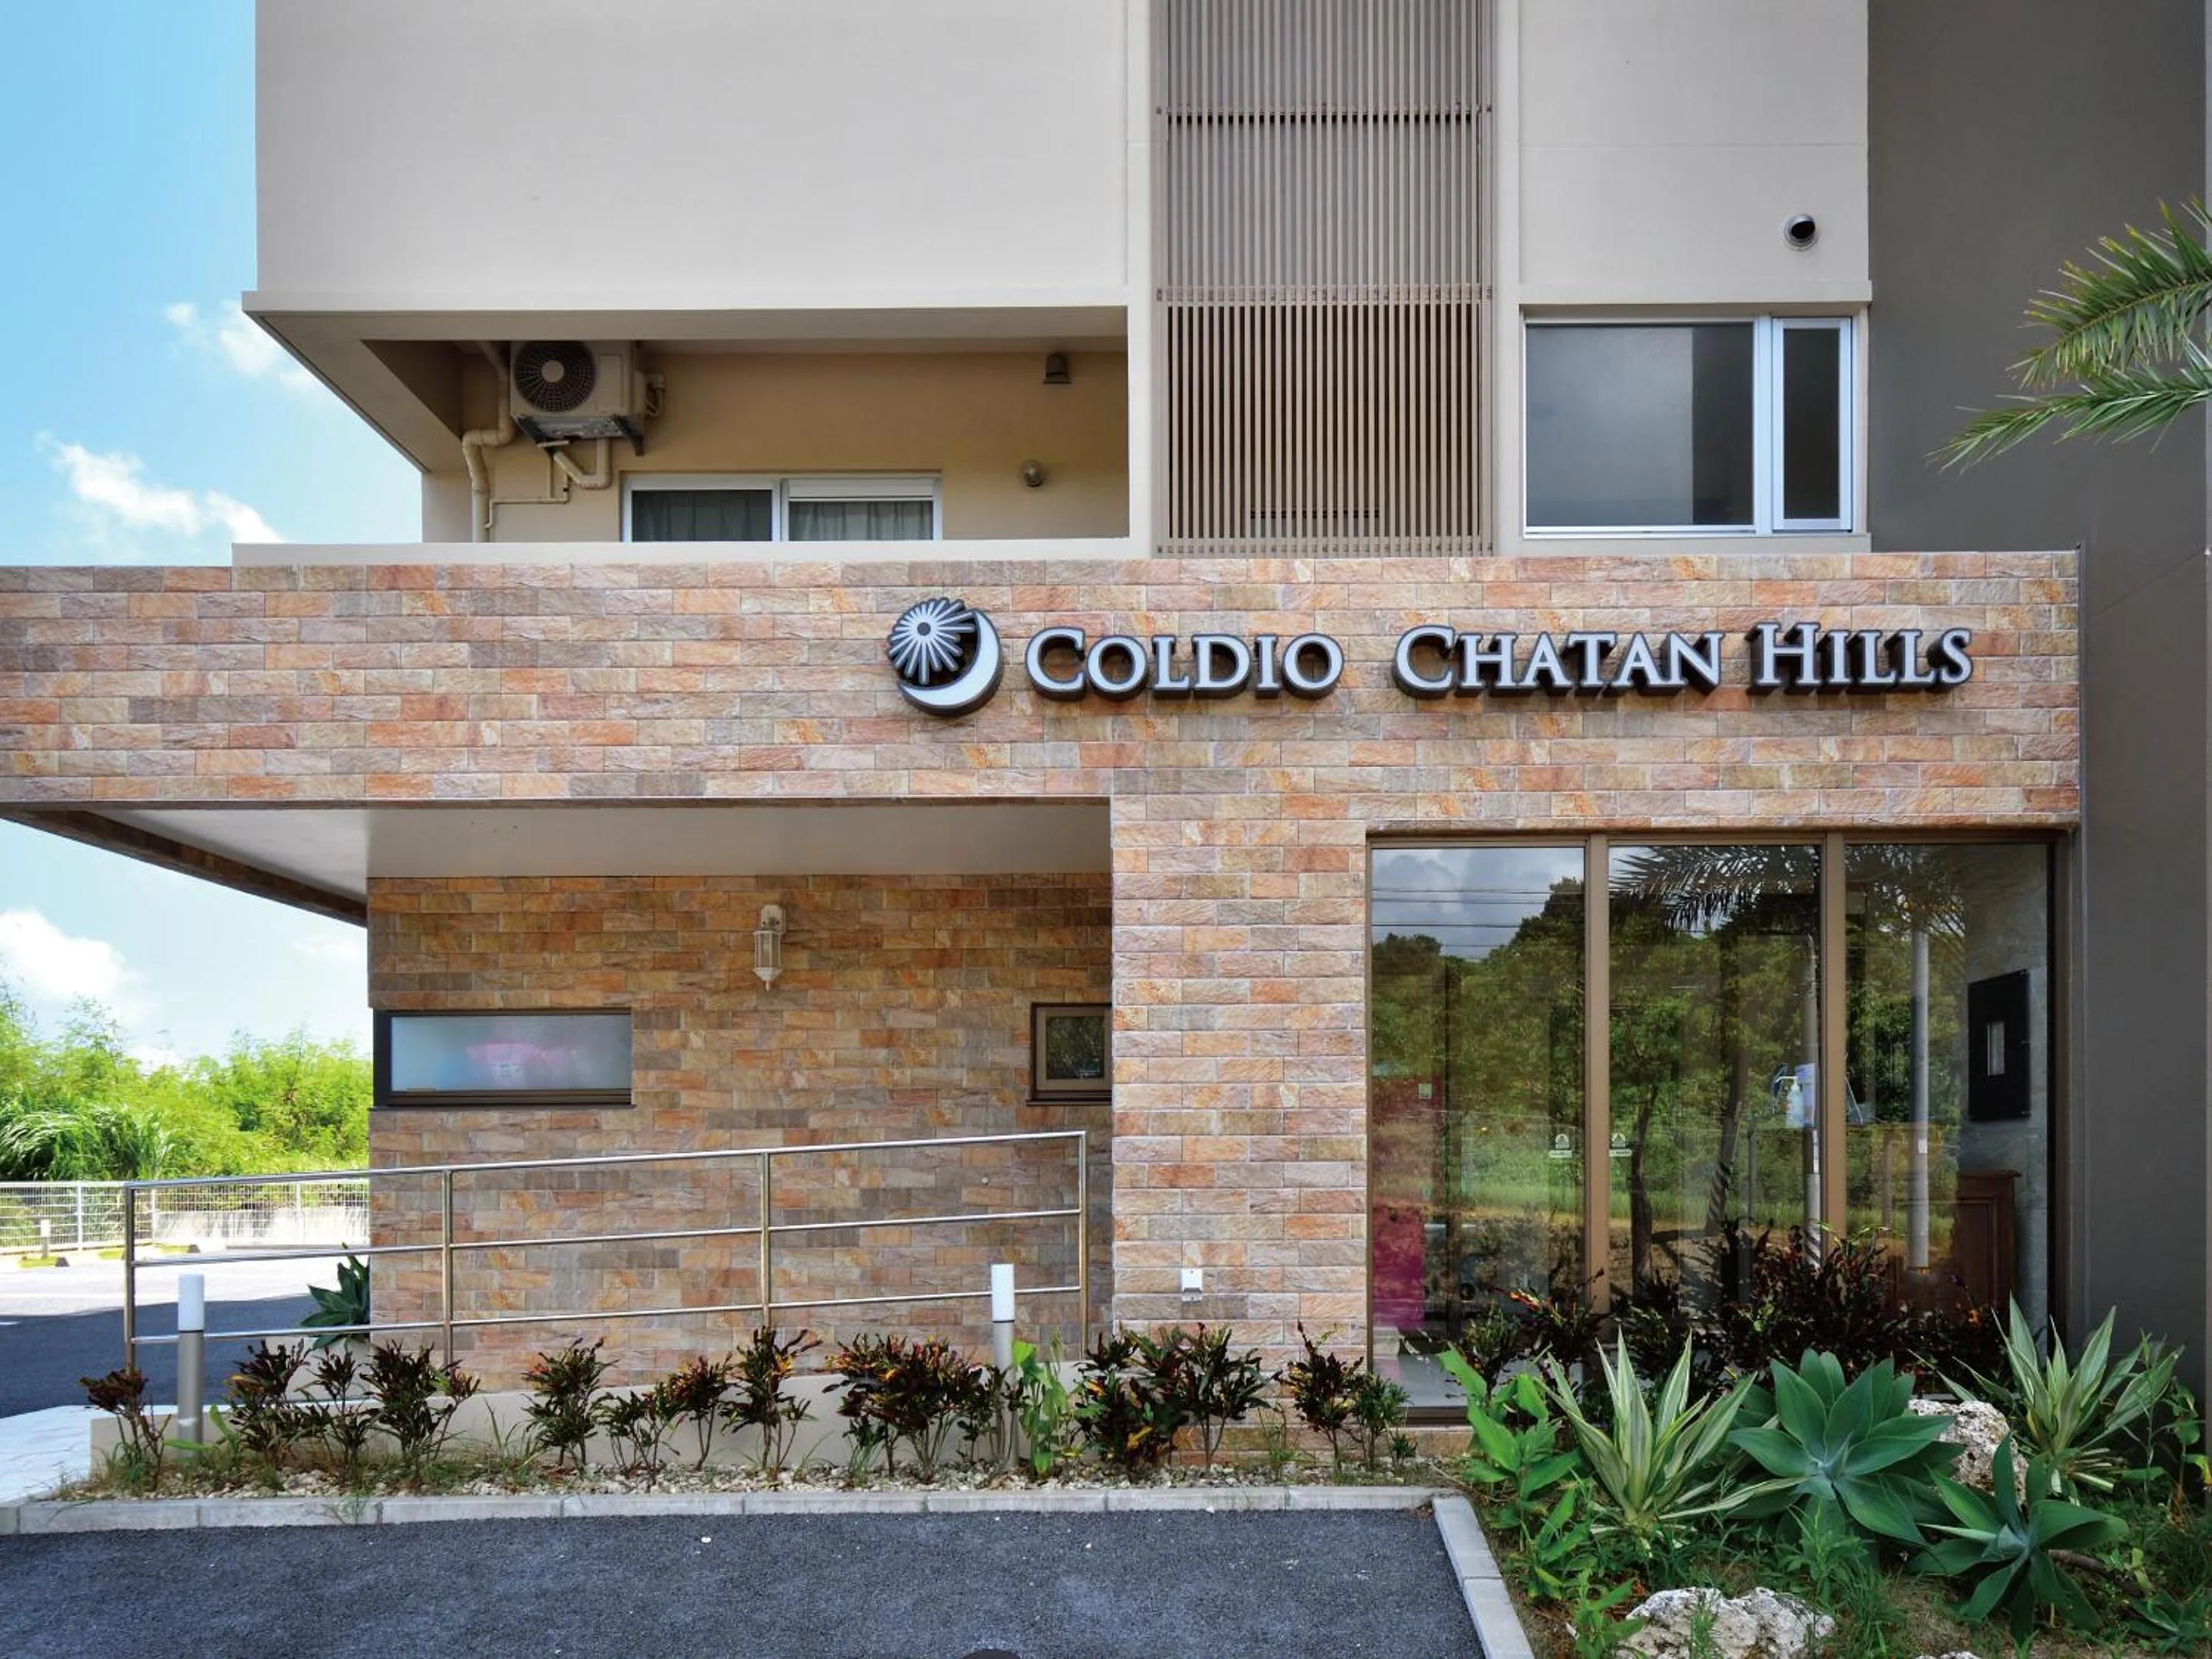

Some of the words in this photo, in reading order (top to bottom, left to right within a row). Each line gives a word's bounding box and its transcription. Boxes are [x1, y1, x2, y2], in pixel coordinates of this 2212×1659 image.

[1025, 626, 1344, 697] COLDIO
[1392, 624, 1724, 694] CHATAN
[1752, 621, 1974, 691] HILLS
